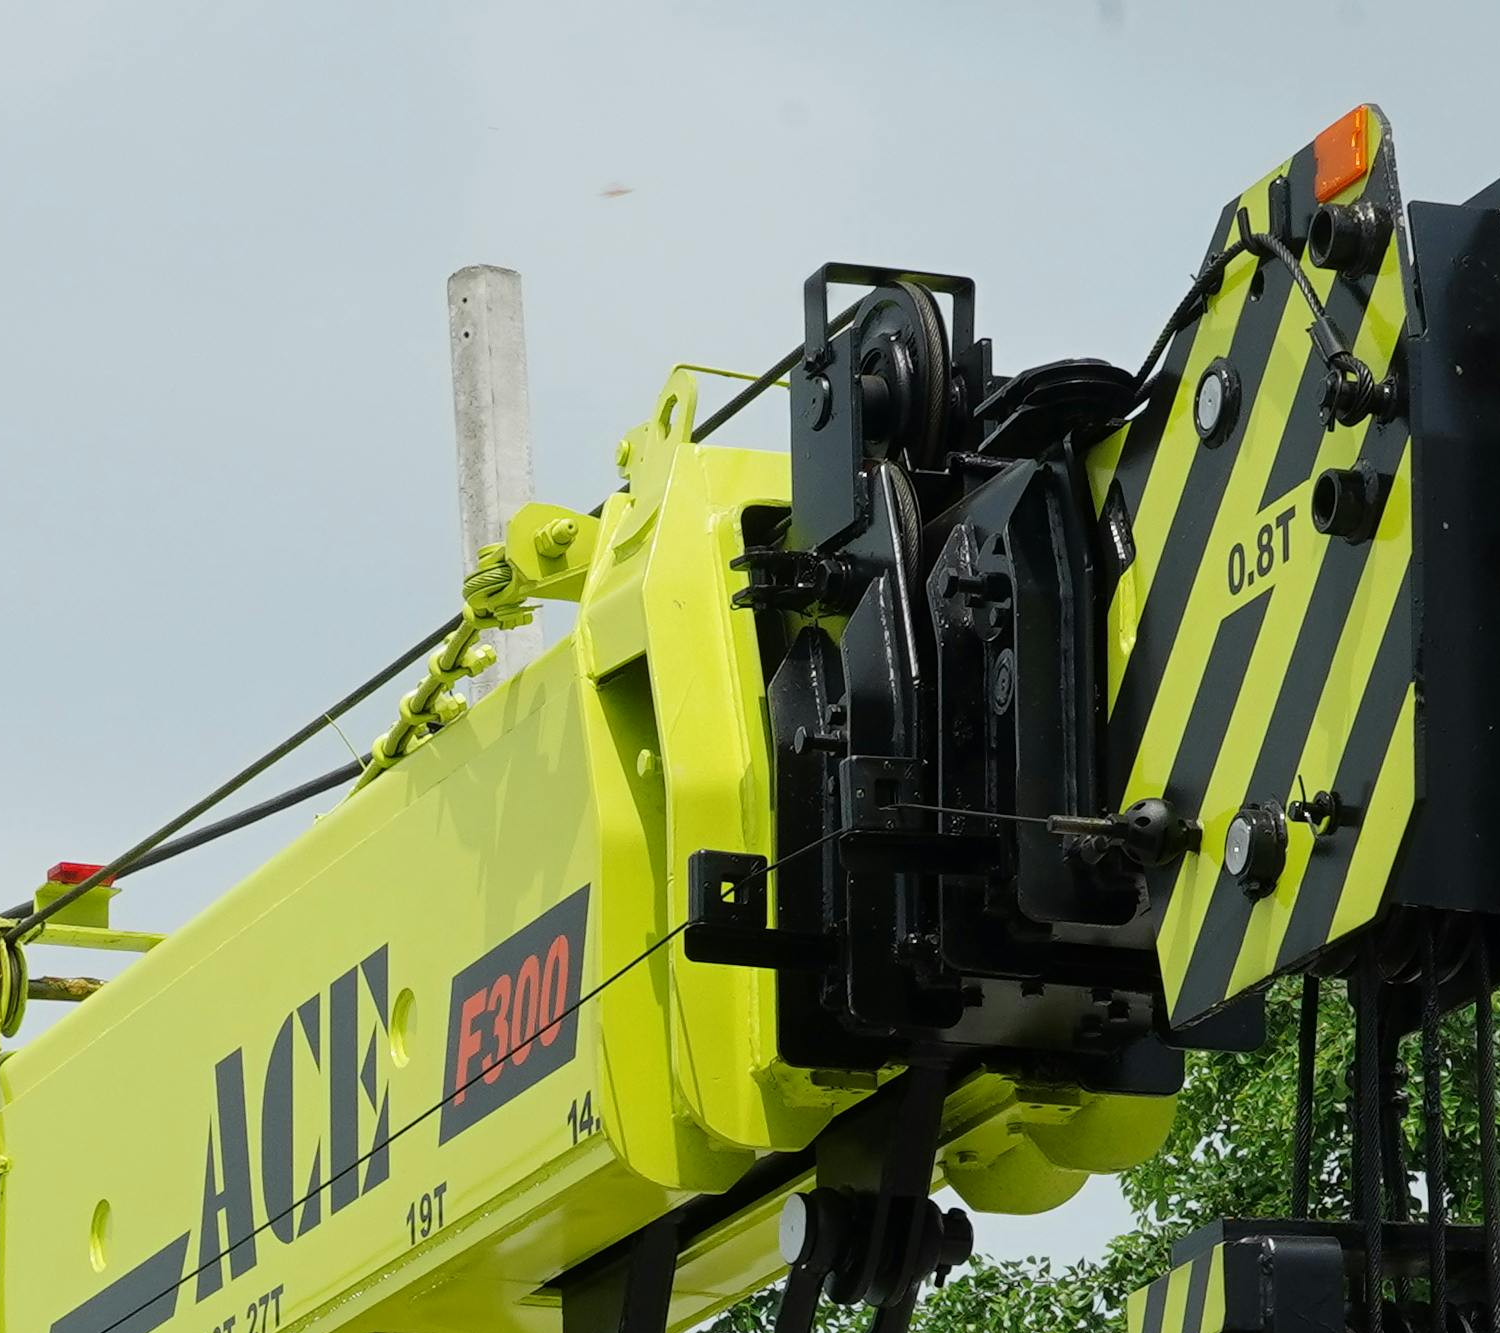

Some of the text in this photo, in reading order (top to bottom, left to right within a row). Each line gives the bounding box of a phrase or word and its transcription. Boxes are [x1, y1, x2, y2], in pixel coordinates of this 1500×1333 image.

[1228, 506, 1296, 596] 0.8T
[453, 933, 570, 1105] F300
[195, 942, 390, 1304] ACE
[406, 1182, 447, 1246] 19T
